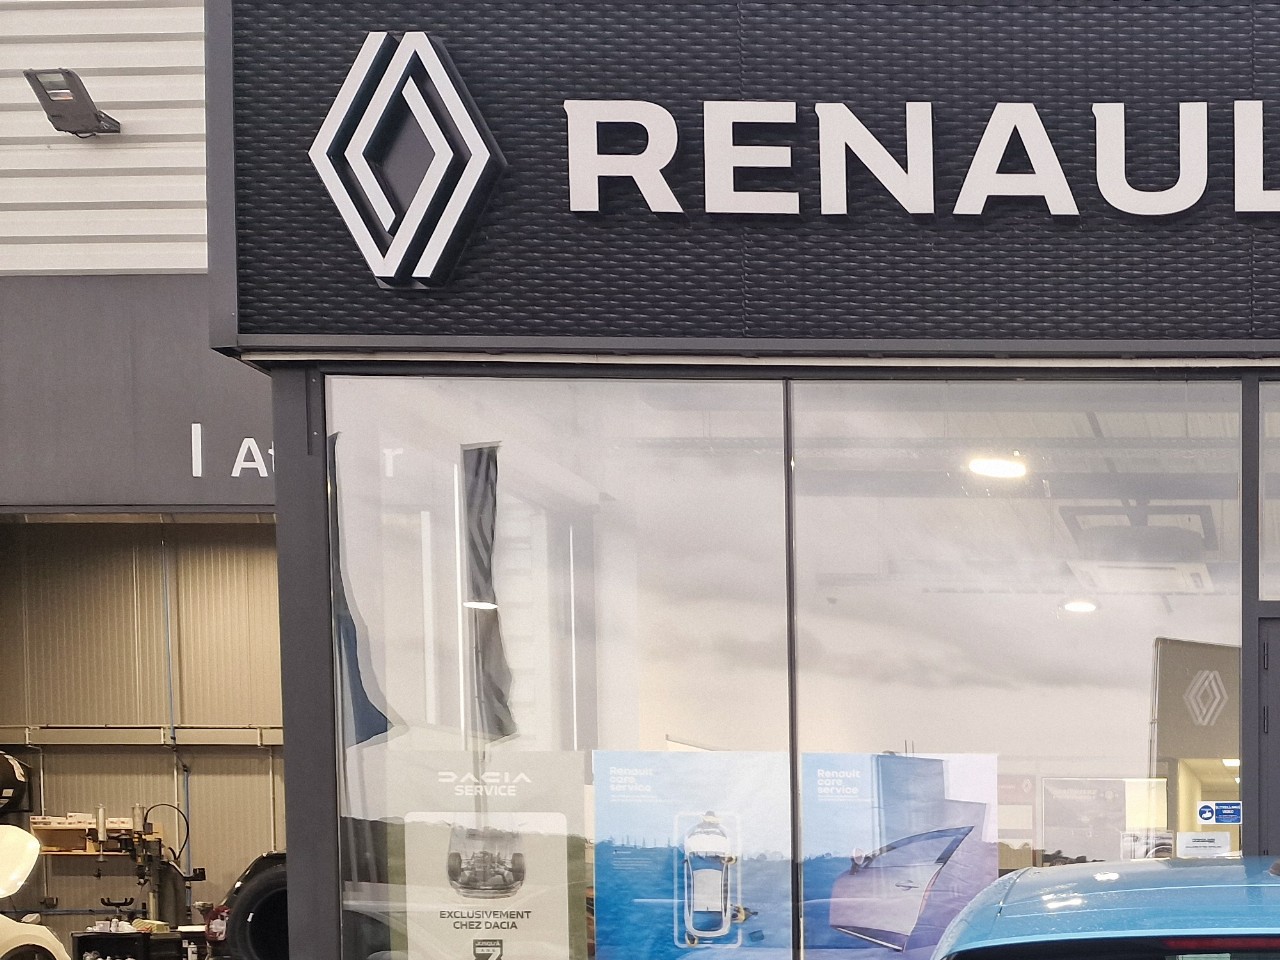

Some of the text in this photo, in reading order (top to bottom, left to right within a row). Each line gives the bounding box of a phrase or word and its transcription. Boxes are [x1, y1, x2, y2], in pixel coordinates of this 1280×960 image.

[438, 771, 532, 783] DACIA
[817, 768, 861, 778] Renault
[454, 785, 517, 796] SERVICE
[817, 786, 859, 794] service
[439, 910, 532, 919] EXCLUSIVEMENT
[453, 921, 518, 930] CHEZ DACIA
